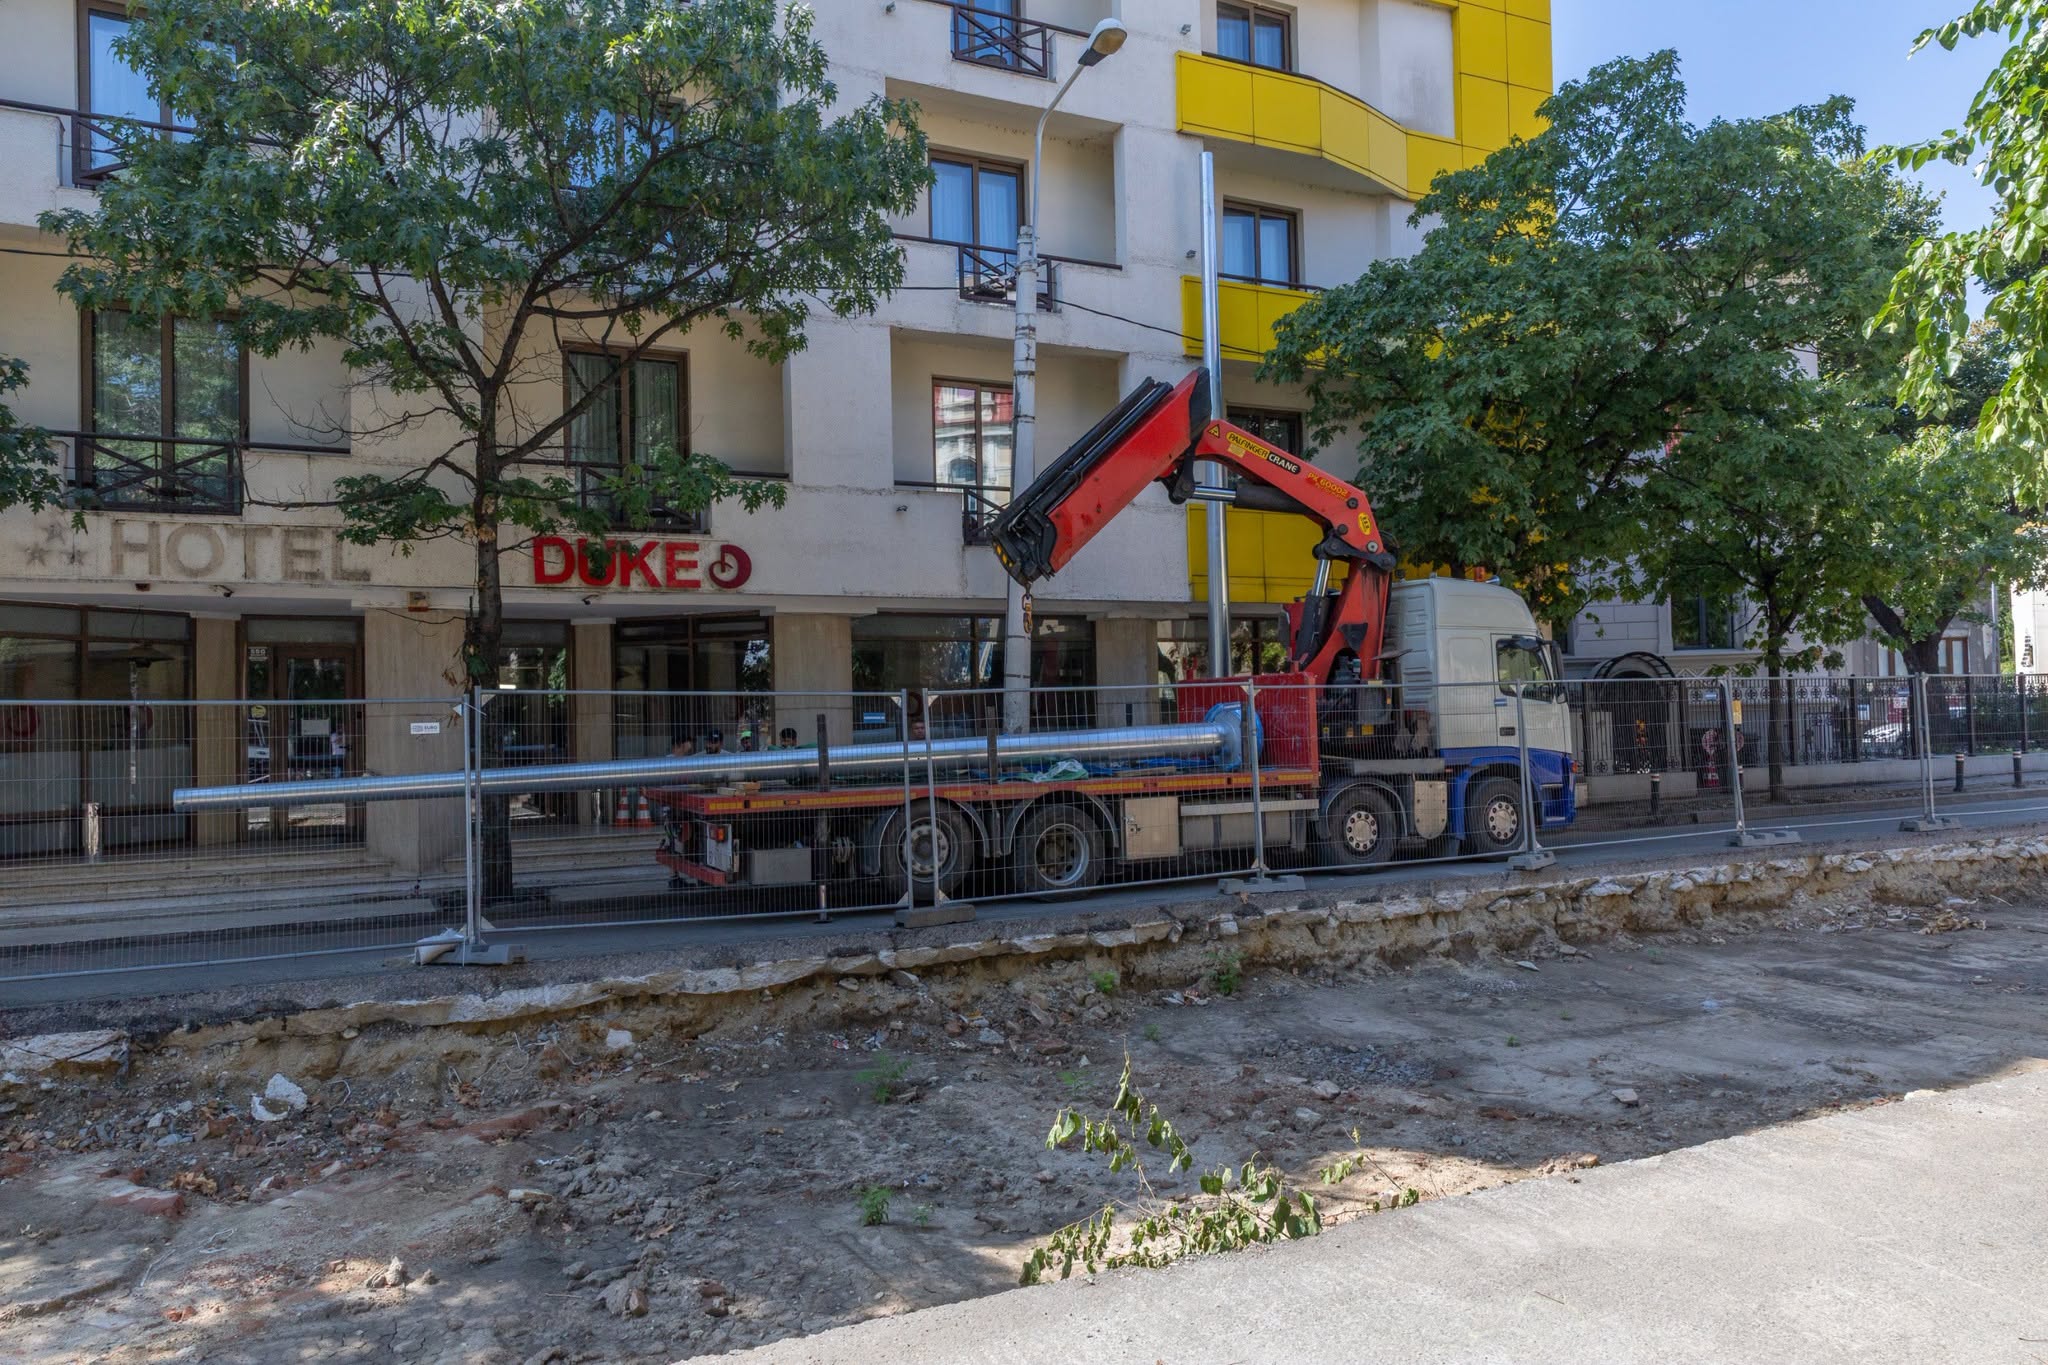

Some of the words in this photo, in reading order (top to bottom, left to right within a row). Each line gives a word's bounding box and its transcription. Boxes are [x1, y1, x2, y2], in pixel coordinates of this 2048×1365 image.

[1228, 433, 1269, 458] PALFINGER
[1268, 453, 1298, 474] CRANE
[1320, 479, 1349, 497] 60002
[111, 522, 371, 582] HOTEL
[532, 536, 701, 588] DUKE
